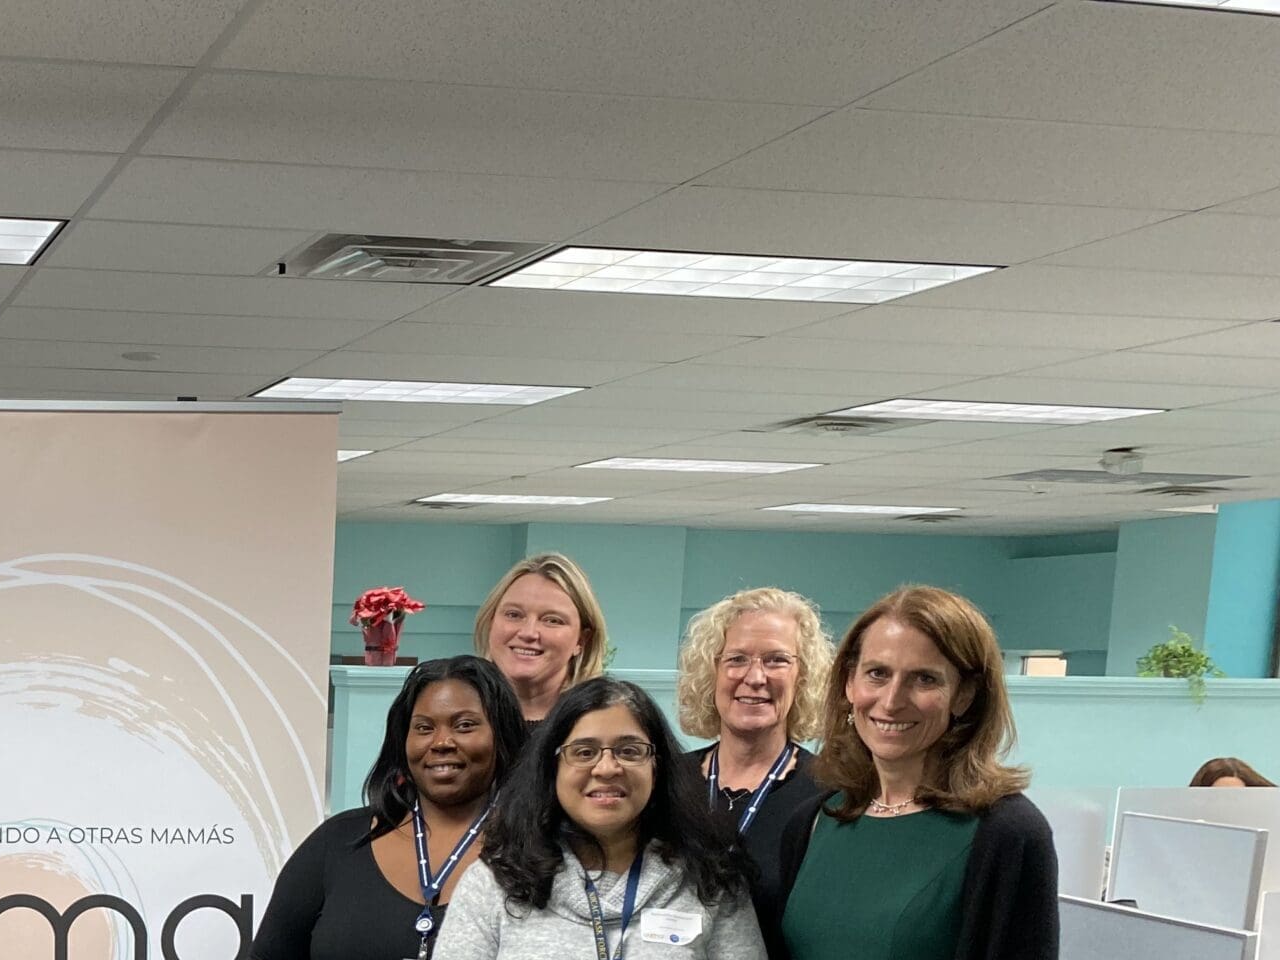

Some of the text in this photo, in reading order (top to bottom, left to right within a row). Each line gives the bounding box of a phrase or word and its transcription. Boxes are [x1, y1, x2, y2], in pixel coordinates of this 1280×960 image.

[46, 827, 63, 844] A
[69, 827, 143, 844] OTRAS
[150, 824, 235, 845] MAMÁS
